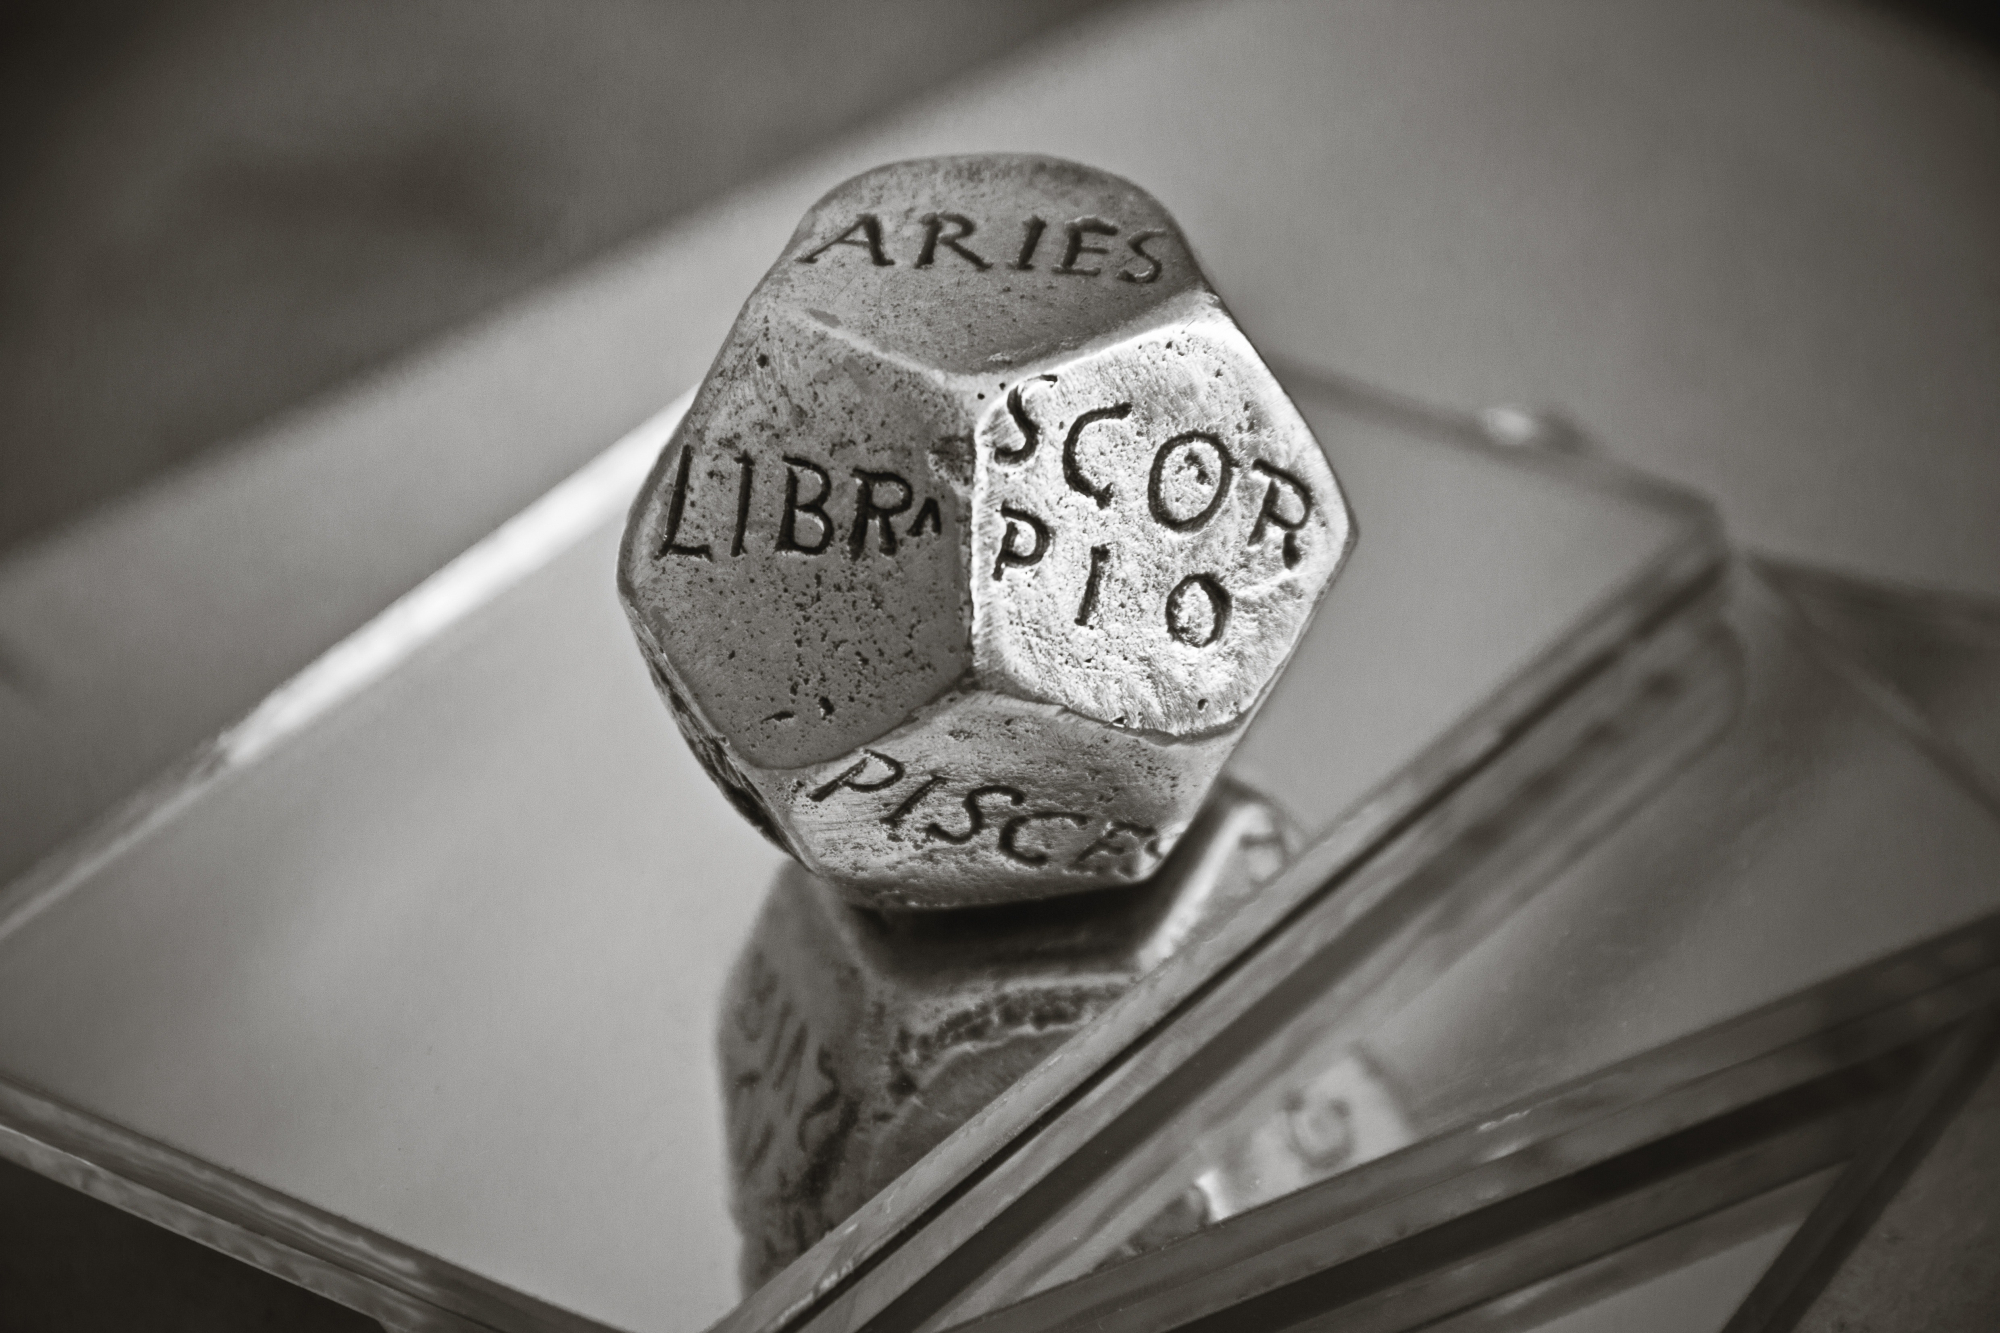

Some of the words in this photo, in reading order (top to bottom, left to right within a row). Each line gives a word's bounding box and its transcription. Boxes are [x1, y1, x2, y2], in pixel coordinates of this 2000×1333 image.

[794, 212, 1168, 283] ARIES
[654, 444, 942, 561] LIBRA
[994, 373, 1313, 570] SCOR
[993, 500, 1232, 648] PIO
